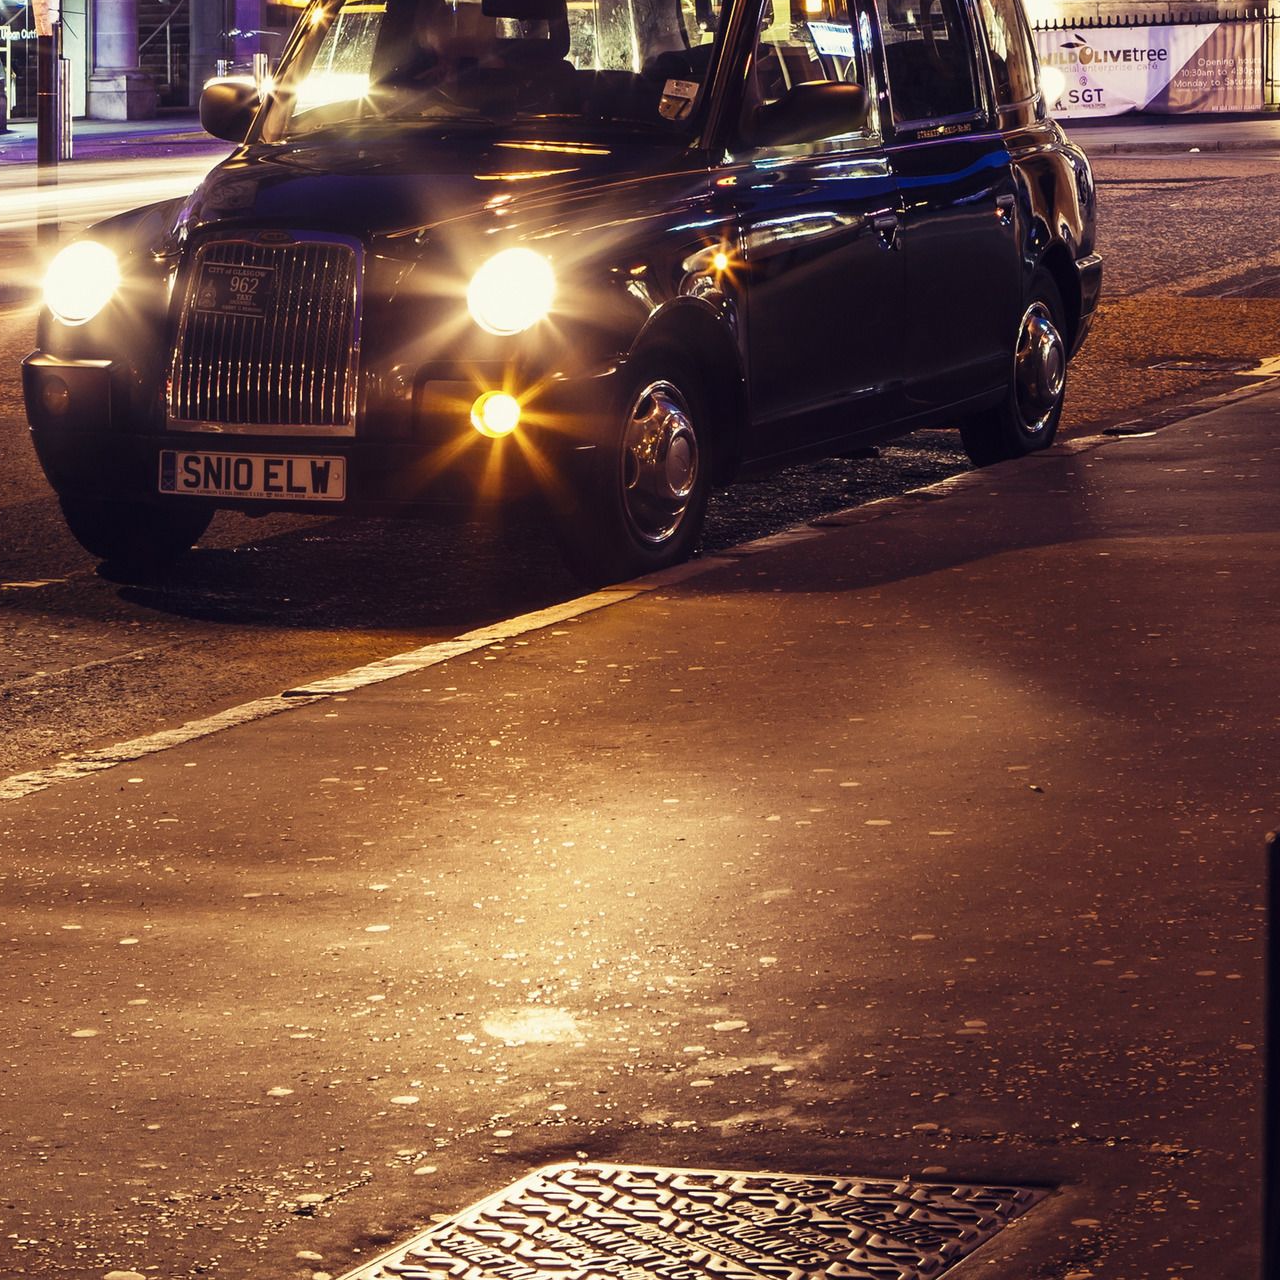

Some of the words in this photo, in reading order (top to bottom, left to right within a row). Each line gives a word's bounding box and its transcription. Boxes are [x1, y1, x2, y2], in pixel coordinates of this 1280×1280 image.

[1136, 61, 1159, 71] café
[1198, 58, 1235, 67] Opening
[1217, 68, 1228, 76] to
[1078, 75, 1088, 87] @
[1173, 79, 1208, 89] Monday
[1210, 79, 1221, 87] to
[1068, 88, 1105, 104] SGT
[230, 275, 259, 294] 962
[183, 455, 254, 491] SN10
[263, 458, 331, 494] ELW
[679, 1206, 741, 1227] PLC
[557, 1219, 666, 1261] STANTON
[718, 1224, 831, 1266] STANTON
